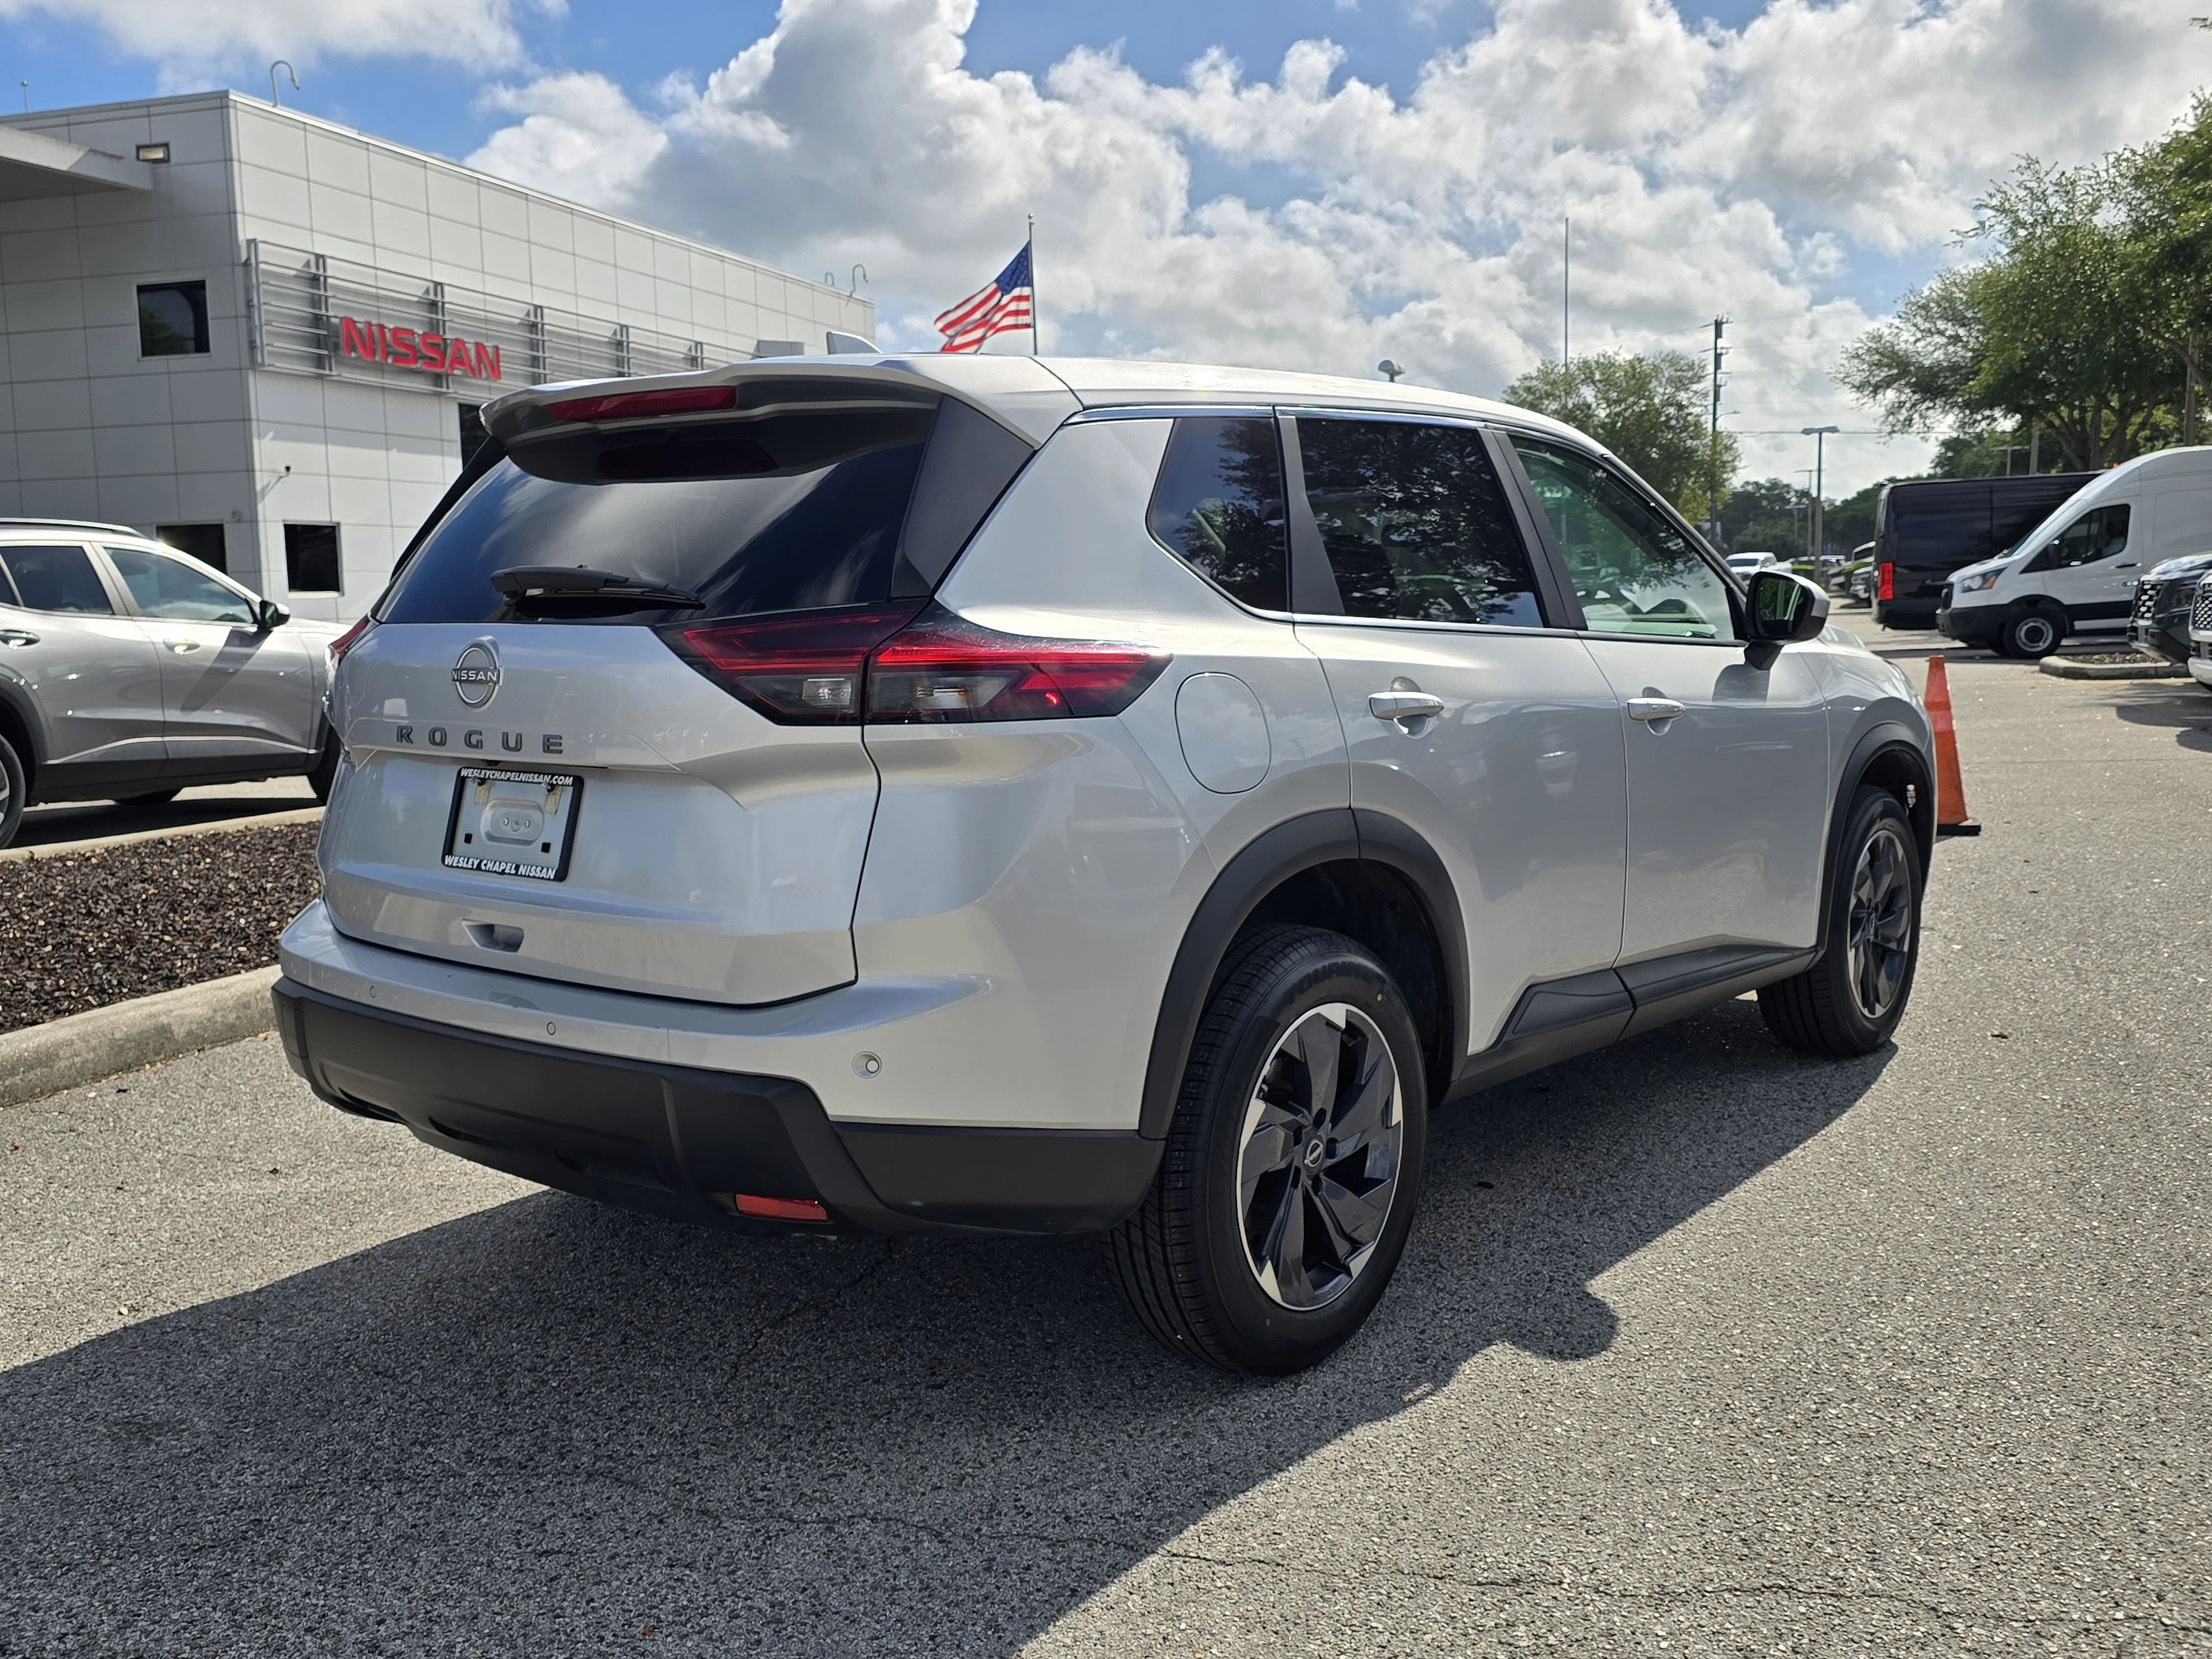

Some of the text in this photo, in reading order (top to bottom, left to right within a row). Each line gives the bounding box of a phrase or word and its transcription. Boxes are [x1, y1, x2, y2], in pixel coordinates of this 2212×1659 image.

[340, 316, 502, 382] NISSAN
[452, 670, 497, 681] NISSAN
[396, 726, 563, 754] ROGUE
[461, 768, 573, 785] WESLEYCHAPELNISSAN.COM
[444, 855, 556, 879] WESLEY CHAPEL NISSAN
